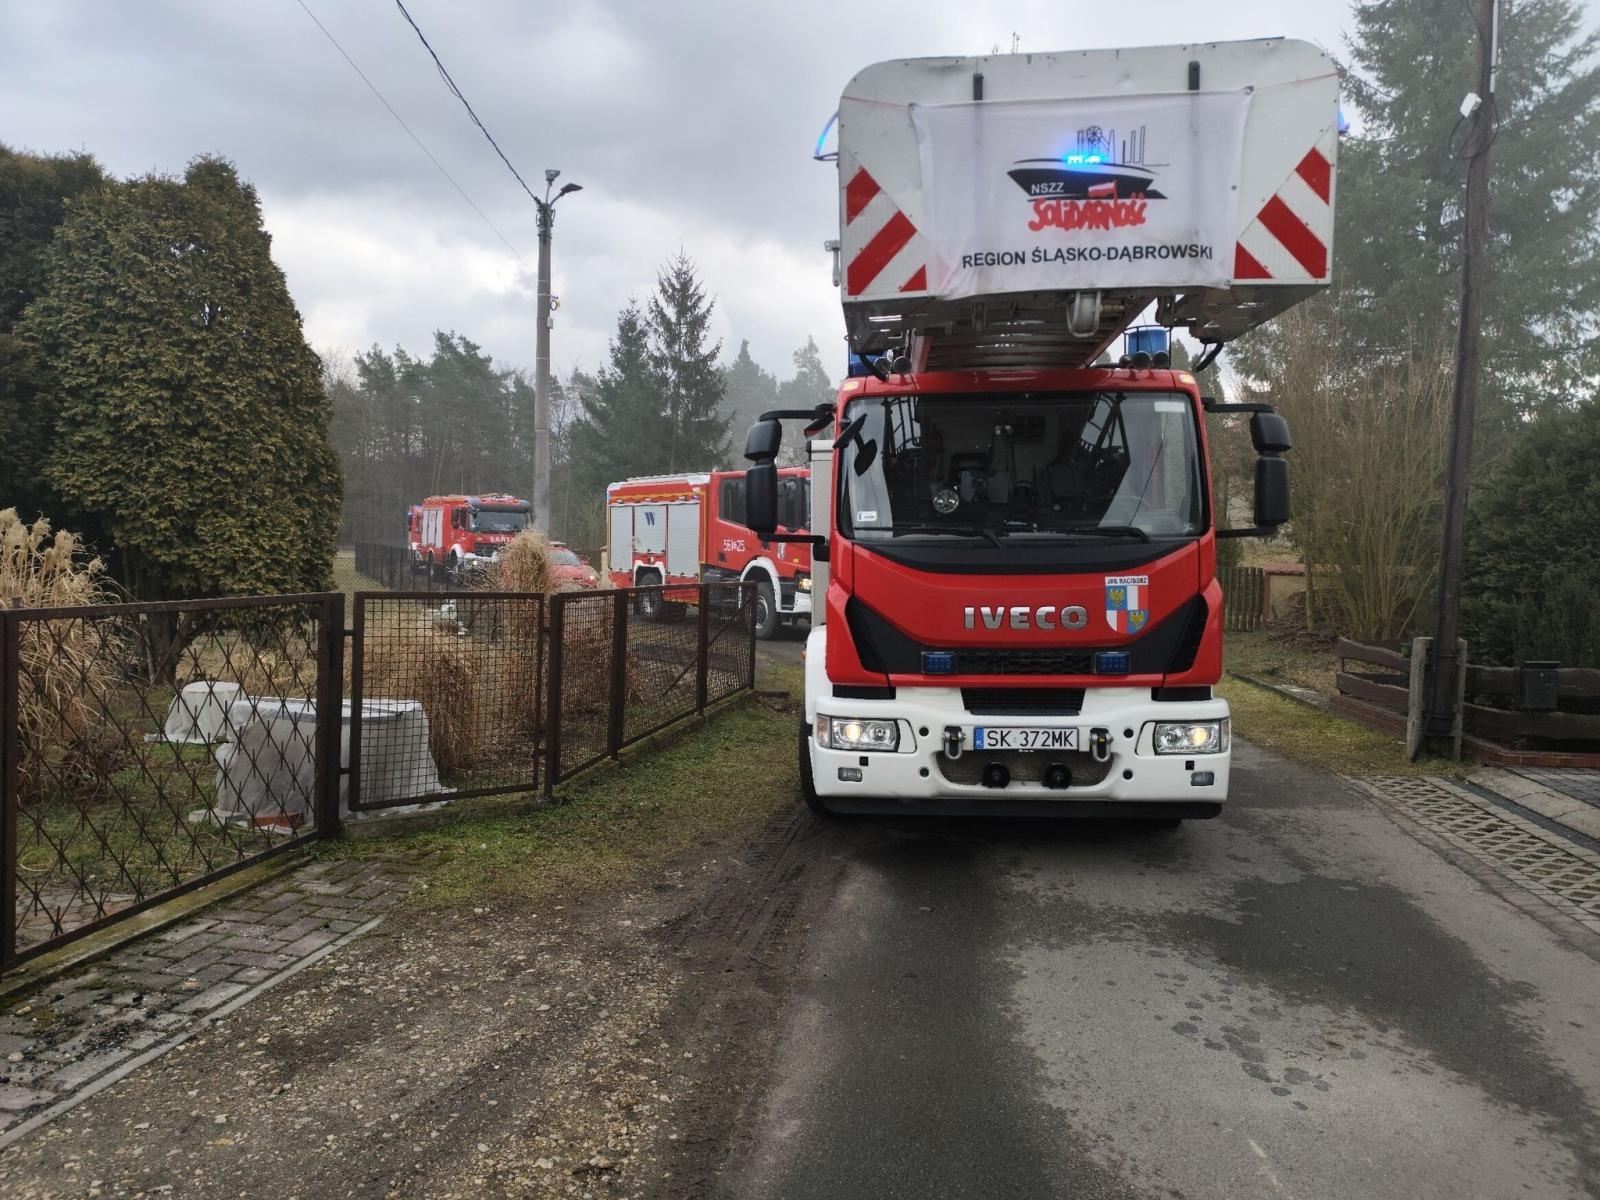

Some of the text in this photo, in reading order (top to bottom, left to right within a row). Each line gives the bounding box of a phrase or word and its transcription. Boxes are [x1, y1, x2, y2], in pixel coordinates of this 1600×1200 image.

[1031, 182, 1065, 194] NSZZ
[962, 244, 1213, 269] REGION ŚLĄSKO-DĄBROWSKI
[964, 605, 1088, 630] IVECO
[987, 730, 1074, 747] SK 372MK
